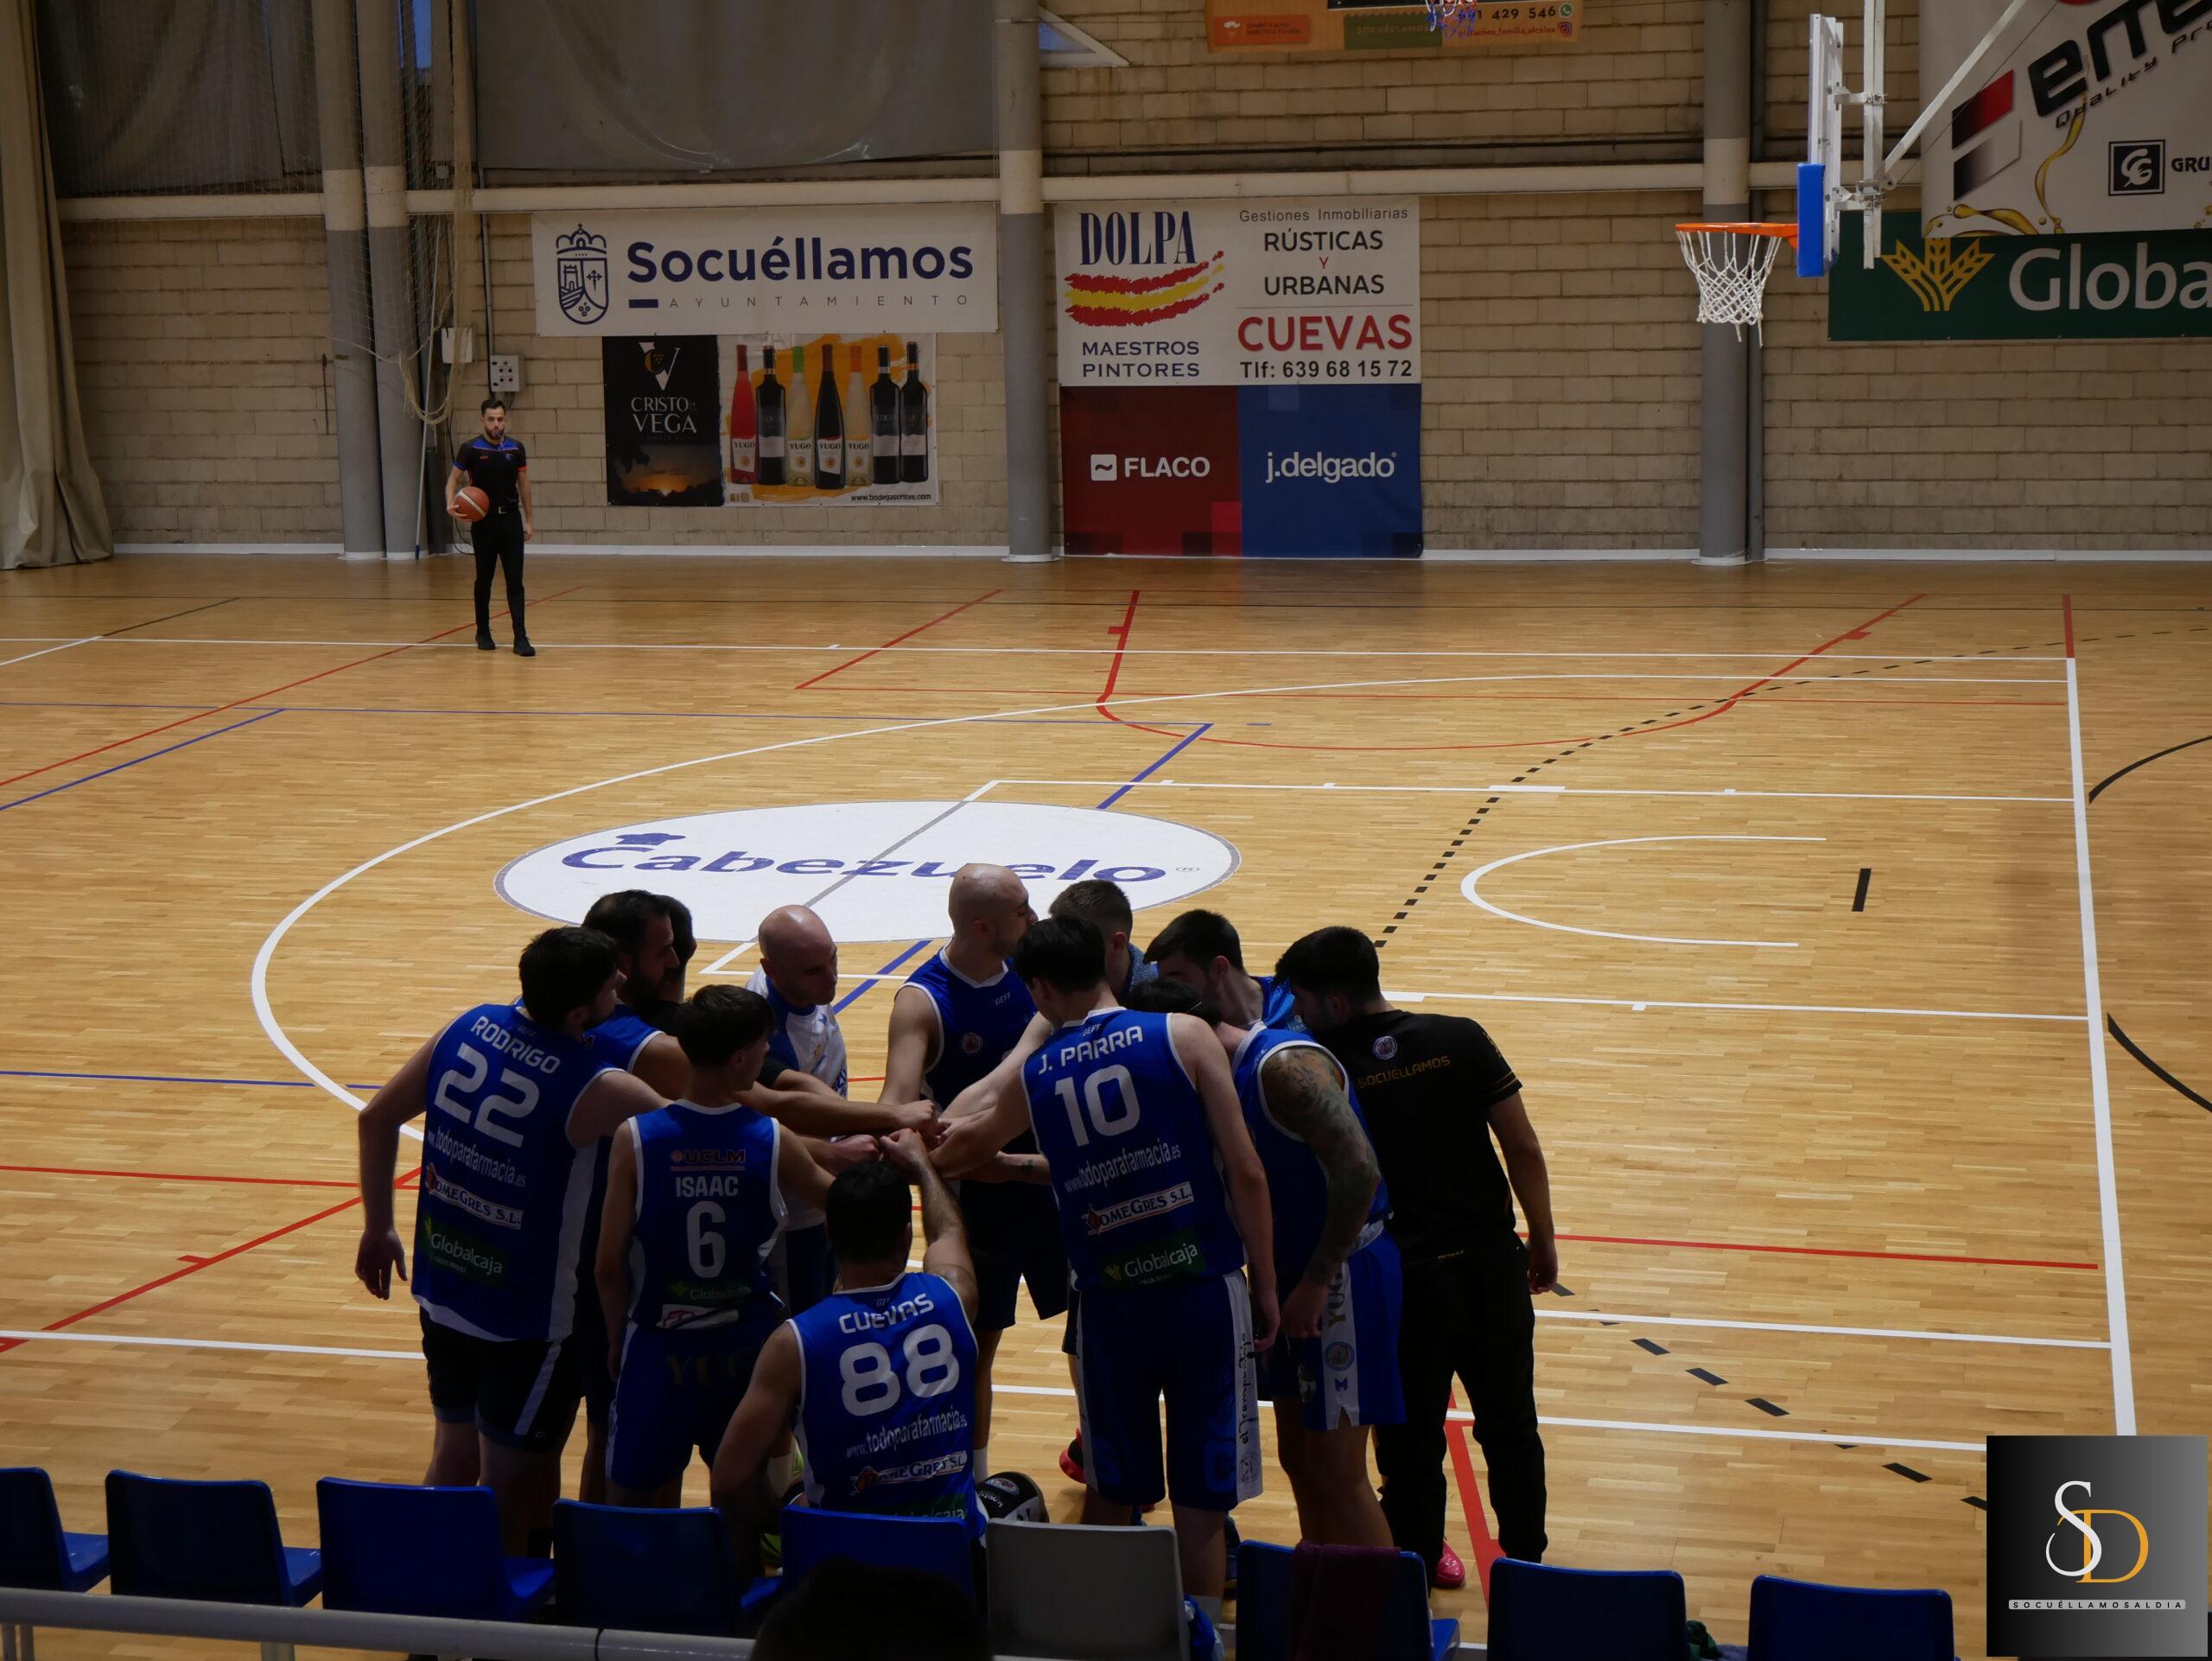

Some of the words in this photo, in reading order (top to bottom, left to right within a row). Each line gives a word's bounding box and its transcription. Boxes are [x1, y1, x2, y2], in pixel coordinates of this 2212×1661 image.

[1492, 9, 1519, 20] 429
[1529, 6, 1556, 19] 546
[2171, 156, 2212, 173] GRU
[1239, 208, 1310, 223] Gestiones
[1318, 207, 1408, 221] Inmobiliarias
[1079, 211, 1198, 266] DOLPA
[1264, 228, 1383, 251] RÚSTICAS
[626, 236, 974, 283] Socuéllamos
[1319, 257, 1329, 270] Y
[1264, 275, 1385, 296] URBANAS
[670, 294, 968, 309] AYUNTAMIENTO
[1237, 314, 1413, 352] CUEVAS
[1082, 340, 1199, 356] MAESTROS
[1083, 363, 1200, 378] PINTORES
[1283, 361, 1319, 378] 639
[1326, 361, 1350, 378] 68
[1357, 360, 1382, 377] 15
[1388, 360, 1413, 377] 72
[630, 397, 689, 412] CRISTO
[632, 413, 698, 434] VEGA
[790, 442, 811, 450] YUGO
[1125, 456, 1211, 478] FLACO
[1265, 451, 1395, 484] j.delgado
[562, 846, 1167, 882] Cabezuelo
[470, 1015, 562, 1075] RODRIGO
[1038, 1053, 1053, 1076] J.
[1060, 1026, 1143, 1067] PARRA
[1357, 1054, 1452, 1090] SOCUELLAMOS
[434, 1042, 540, 1148] 22
[1054, 1064, 1141, 1148] 10
[684, 1149, 747, 1162] UCLM
[675, 1175, 739, 1198] ISAAC
[686, 1200, 726, 1279] 6
[430, 1232, 503, 1276] Globalcaja
[1124, 1242, 1198, 1278] Globalcaja
[838, 1293, 935, 1334] CUEVAS
[838, 1323, 960, 1416] 88
